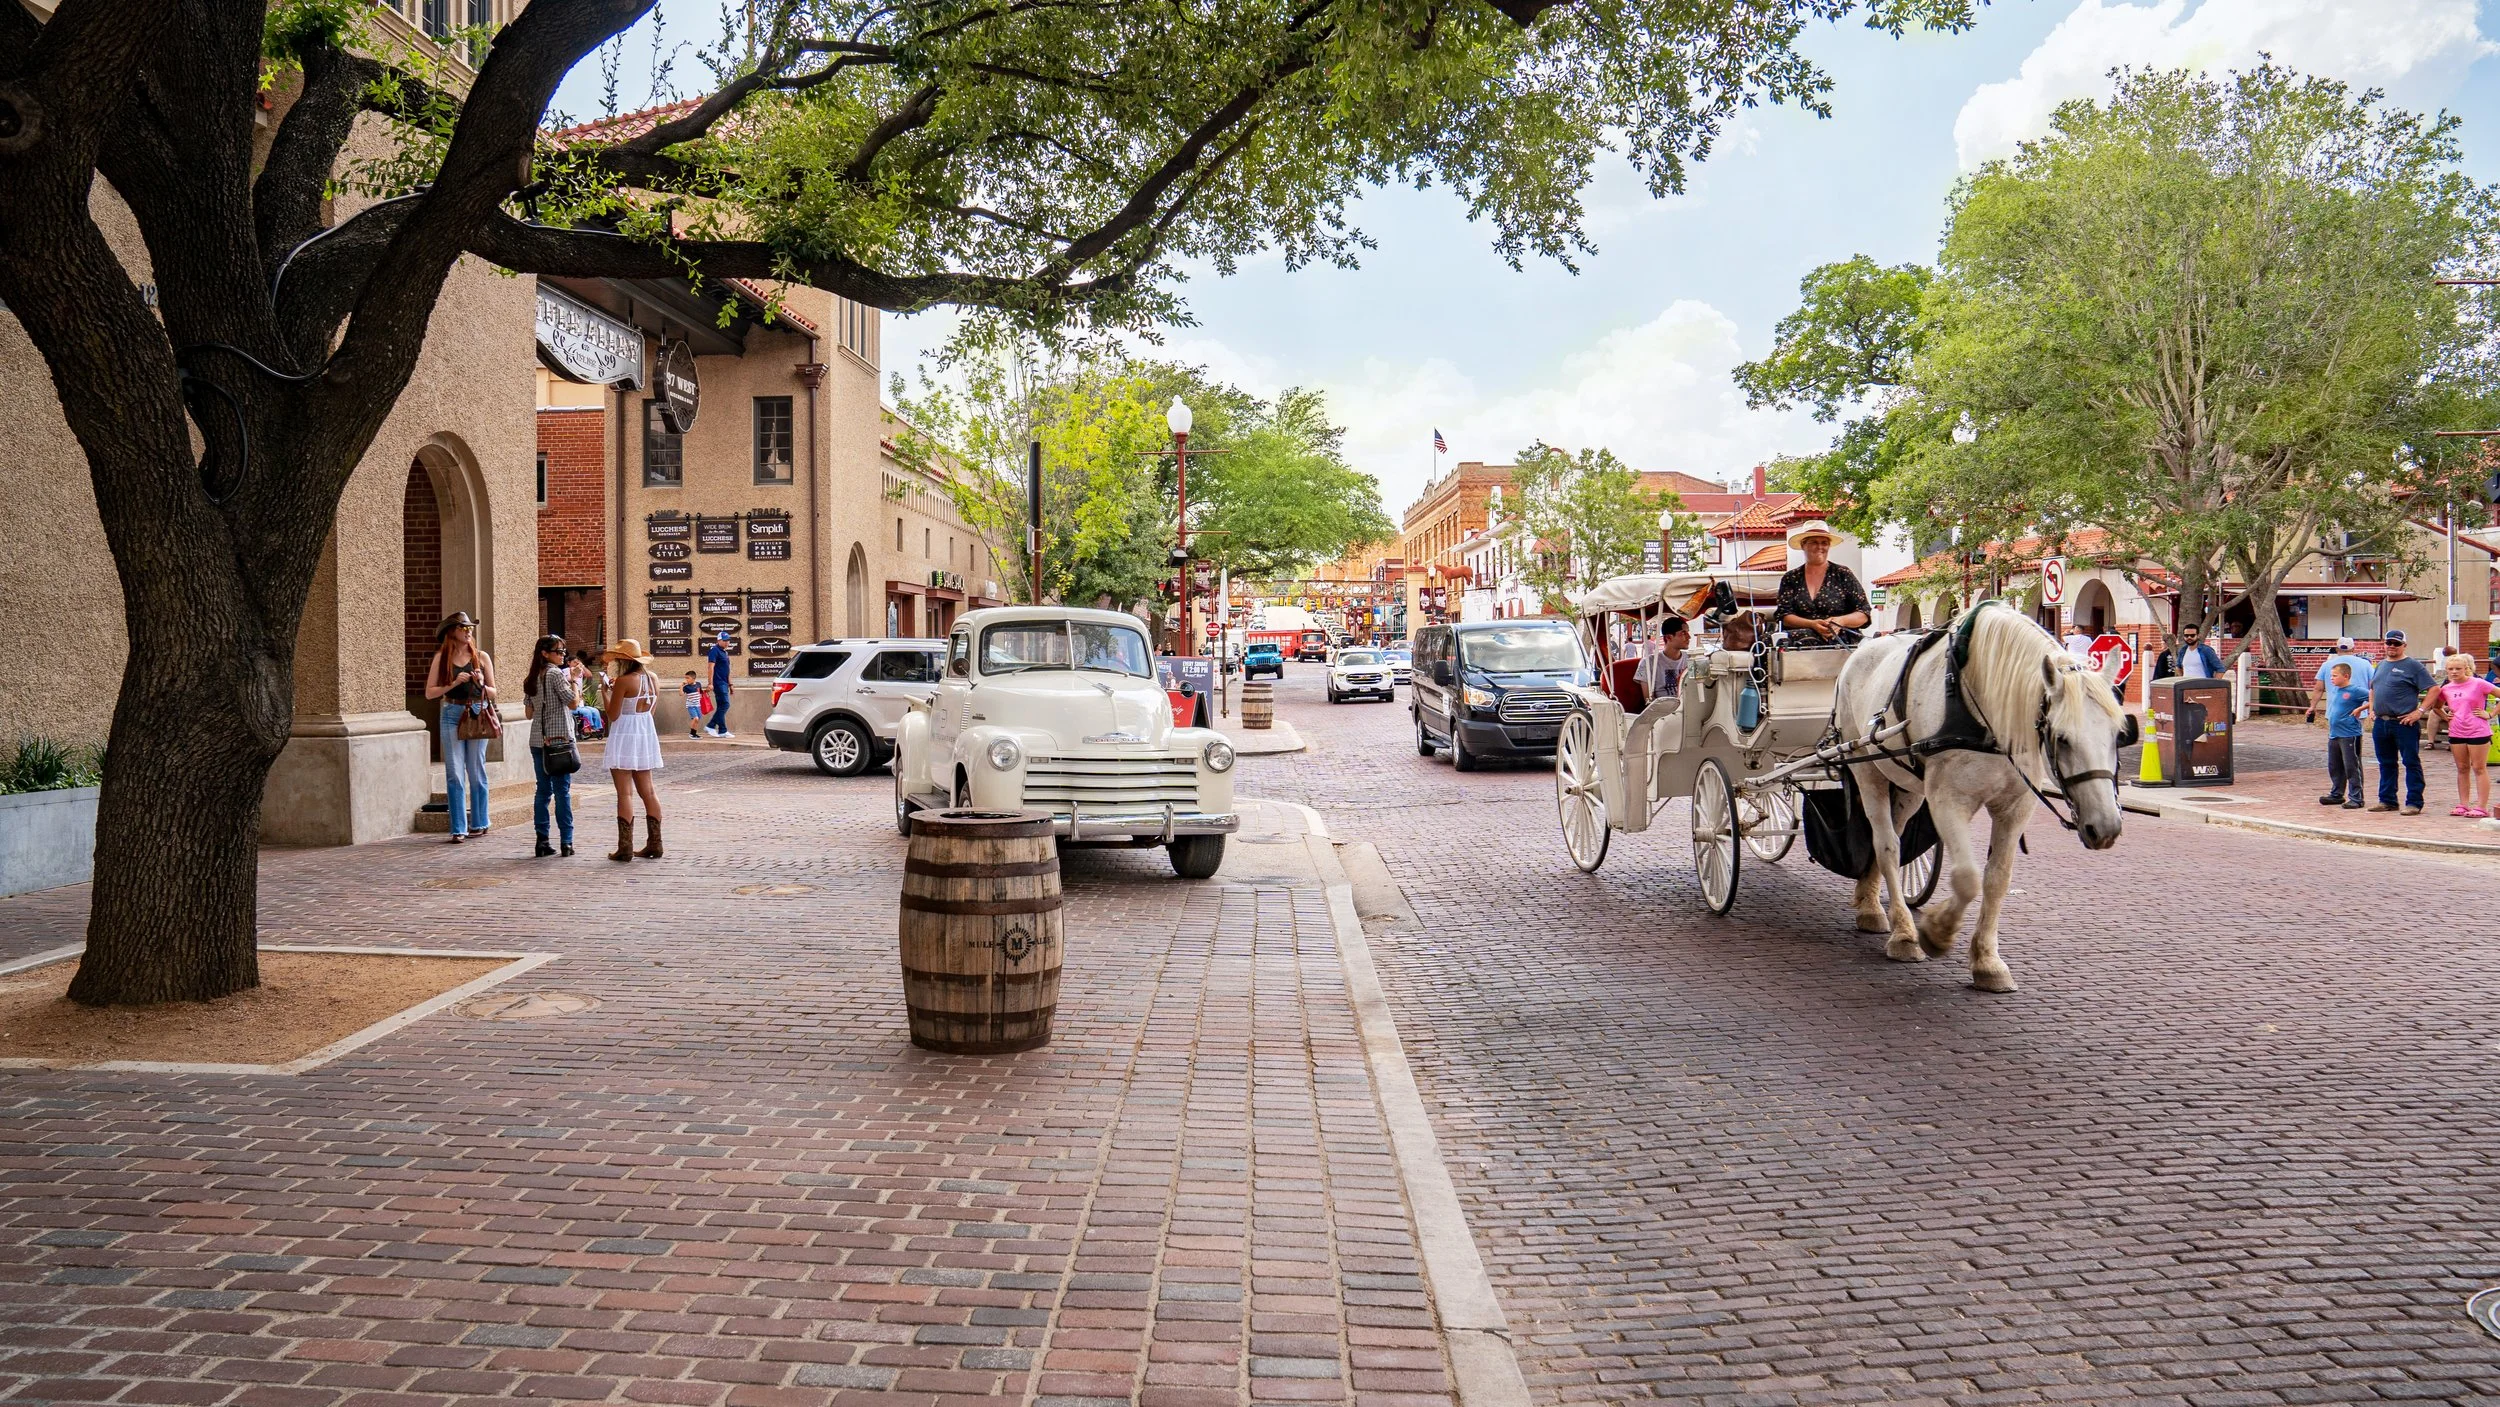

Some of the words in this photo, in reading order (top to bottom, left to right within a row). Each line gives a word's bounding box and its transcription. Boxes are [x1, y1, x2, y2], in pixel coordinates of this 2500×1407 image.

[585, 320, 638, 363] ALLEY
[666, 371, 676, 387] 97
[677, 376, 697, 395] WEST
[752, 508, 782, 516] TRADE
[657, 585, 673, 593] EAT
[660, 619, 681, 629] MELT
[753, 661, 787, 669] Sidesaddle
[2090, 651, 2130, 670] STP
[1010, 937, 1023, 950] M
